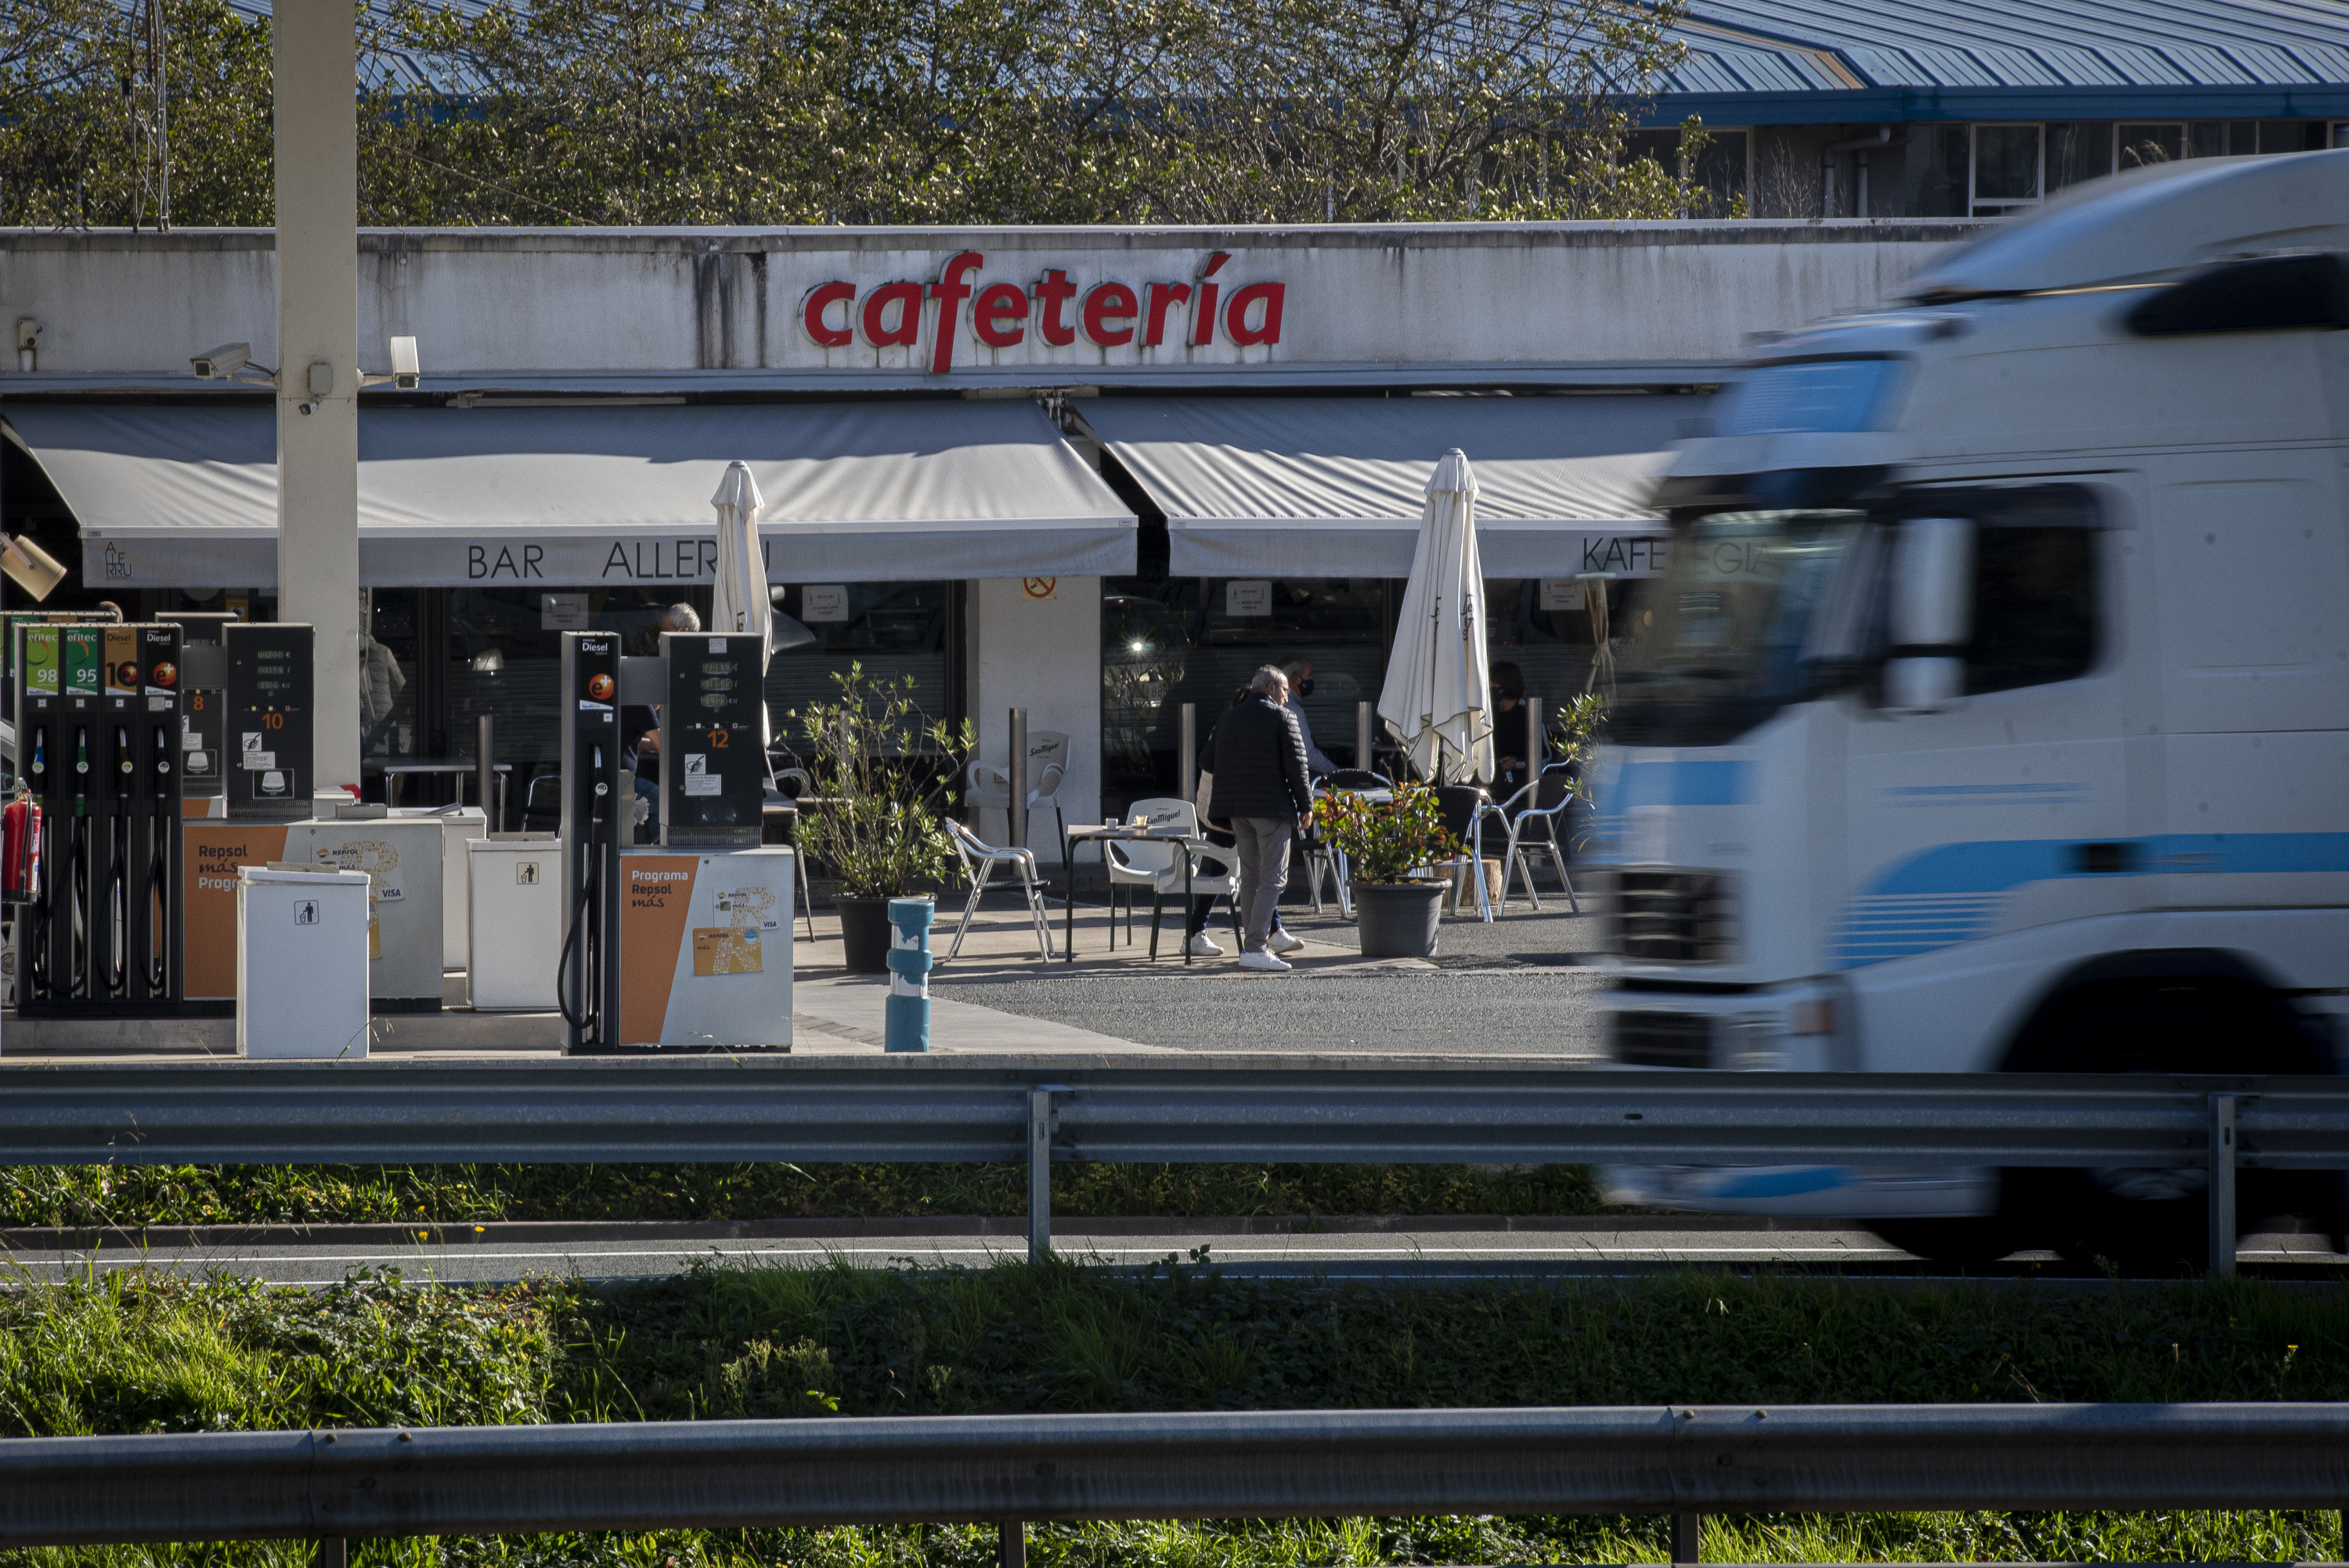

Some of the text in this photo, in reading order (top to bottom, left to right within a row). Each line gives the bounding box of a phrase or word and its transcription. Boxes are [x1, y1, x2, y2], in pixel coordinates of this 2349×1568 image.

[802, 251, 1286, 373] cafetería
[468, 539, 770, 579] BAR ALLER
[27, 633, 58, 643] efitec
[67, 633, 97, 643] efitec
[106, 633, 131, 642] Diesel
[146, 633, 171, 642] Diesel
[582, 642, 608, 651] Diesel
[37, 669, 58, 683] 98
[77, 669, 97, 683] 95
[193, 696, 204, 711] 8
[262, 713, 283, 730] 10
[707, 730, 729, 748] 12
[199, 844, 248, 860] Repsol
[199, 858, 238, 873] más
[632, 870, 688, 883] Programa
[198, 877, 237, 892] Progr
[632, 883, 672, 897] Repsol
[382, 889, 401, 898] VISA
[632, 896, 665, 908] más
